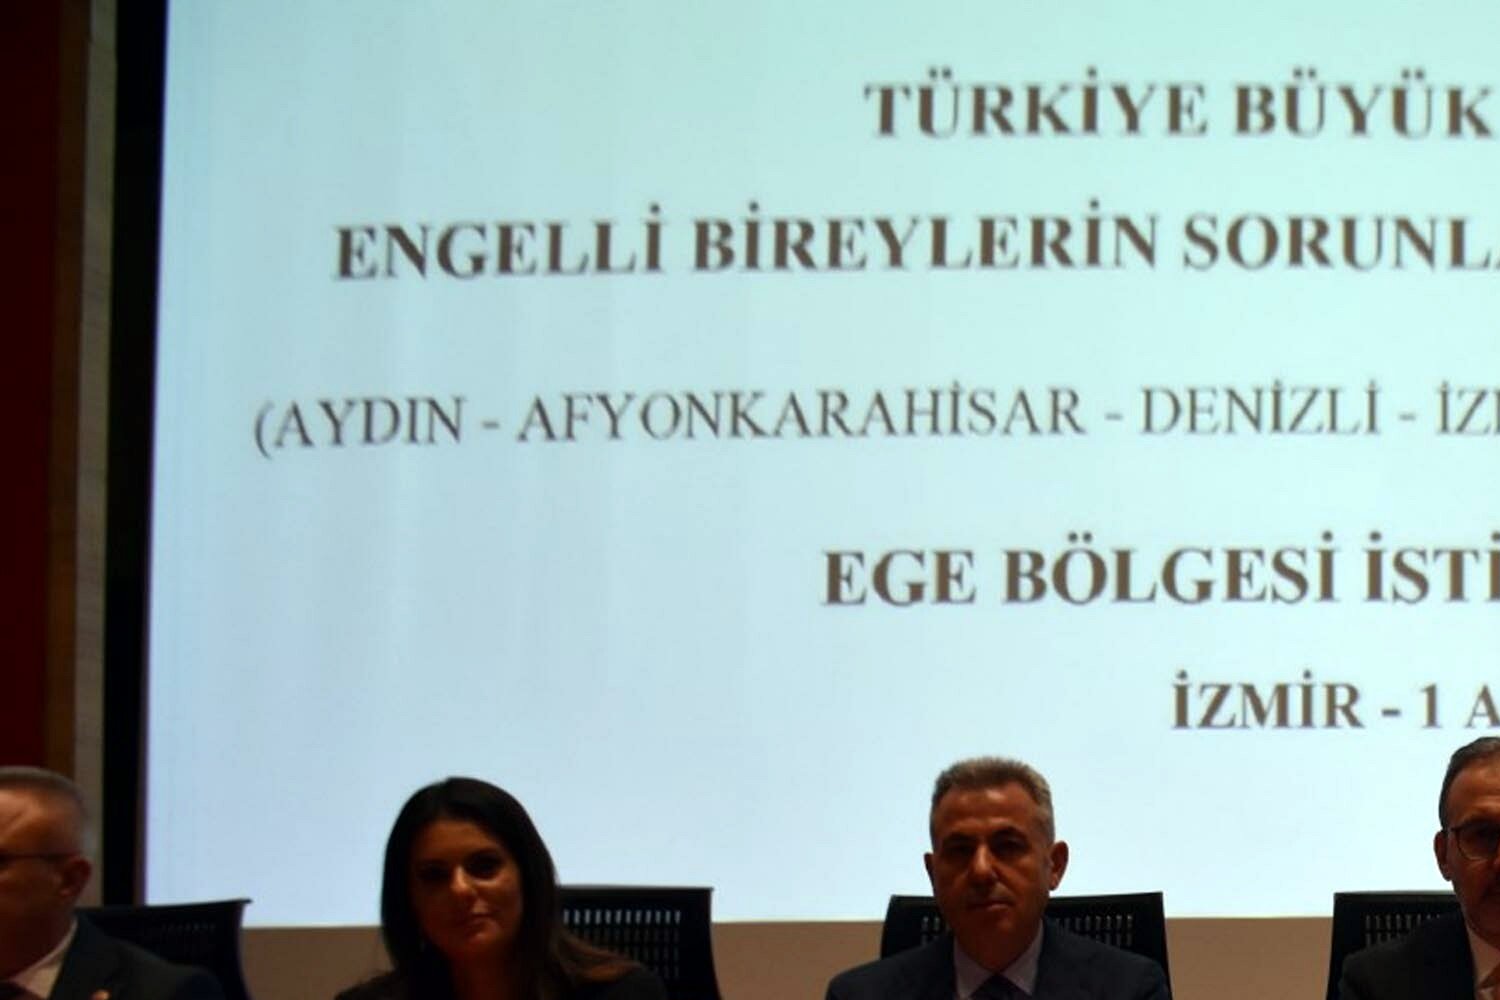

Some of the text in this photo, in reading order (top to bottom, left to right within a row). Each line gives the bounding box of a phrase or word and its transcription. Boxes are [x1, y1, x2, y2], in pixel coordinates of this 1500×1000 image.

[864, 66, 1207, 138] TÜRKİYE
[1235, 67, 1492, 138] BÜYÜK
[338, 203, 662, 280] ENGELLİ
[694, 198, 1157, 272] BİREYLERİN
[254, 396, 465, 459] (AYDIN
[517, 380, 1086, 442] AFYONKARAHİSAR
[1142, 379, 1380, 437] DENİZLİ
[824, 550, 976, 607] EGE
[1004, 530, 1336, 606] BÖLGESİ
[1173, 669, 1364, 730] İZMİR
[1422, 684, 1440, 728] 1
